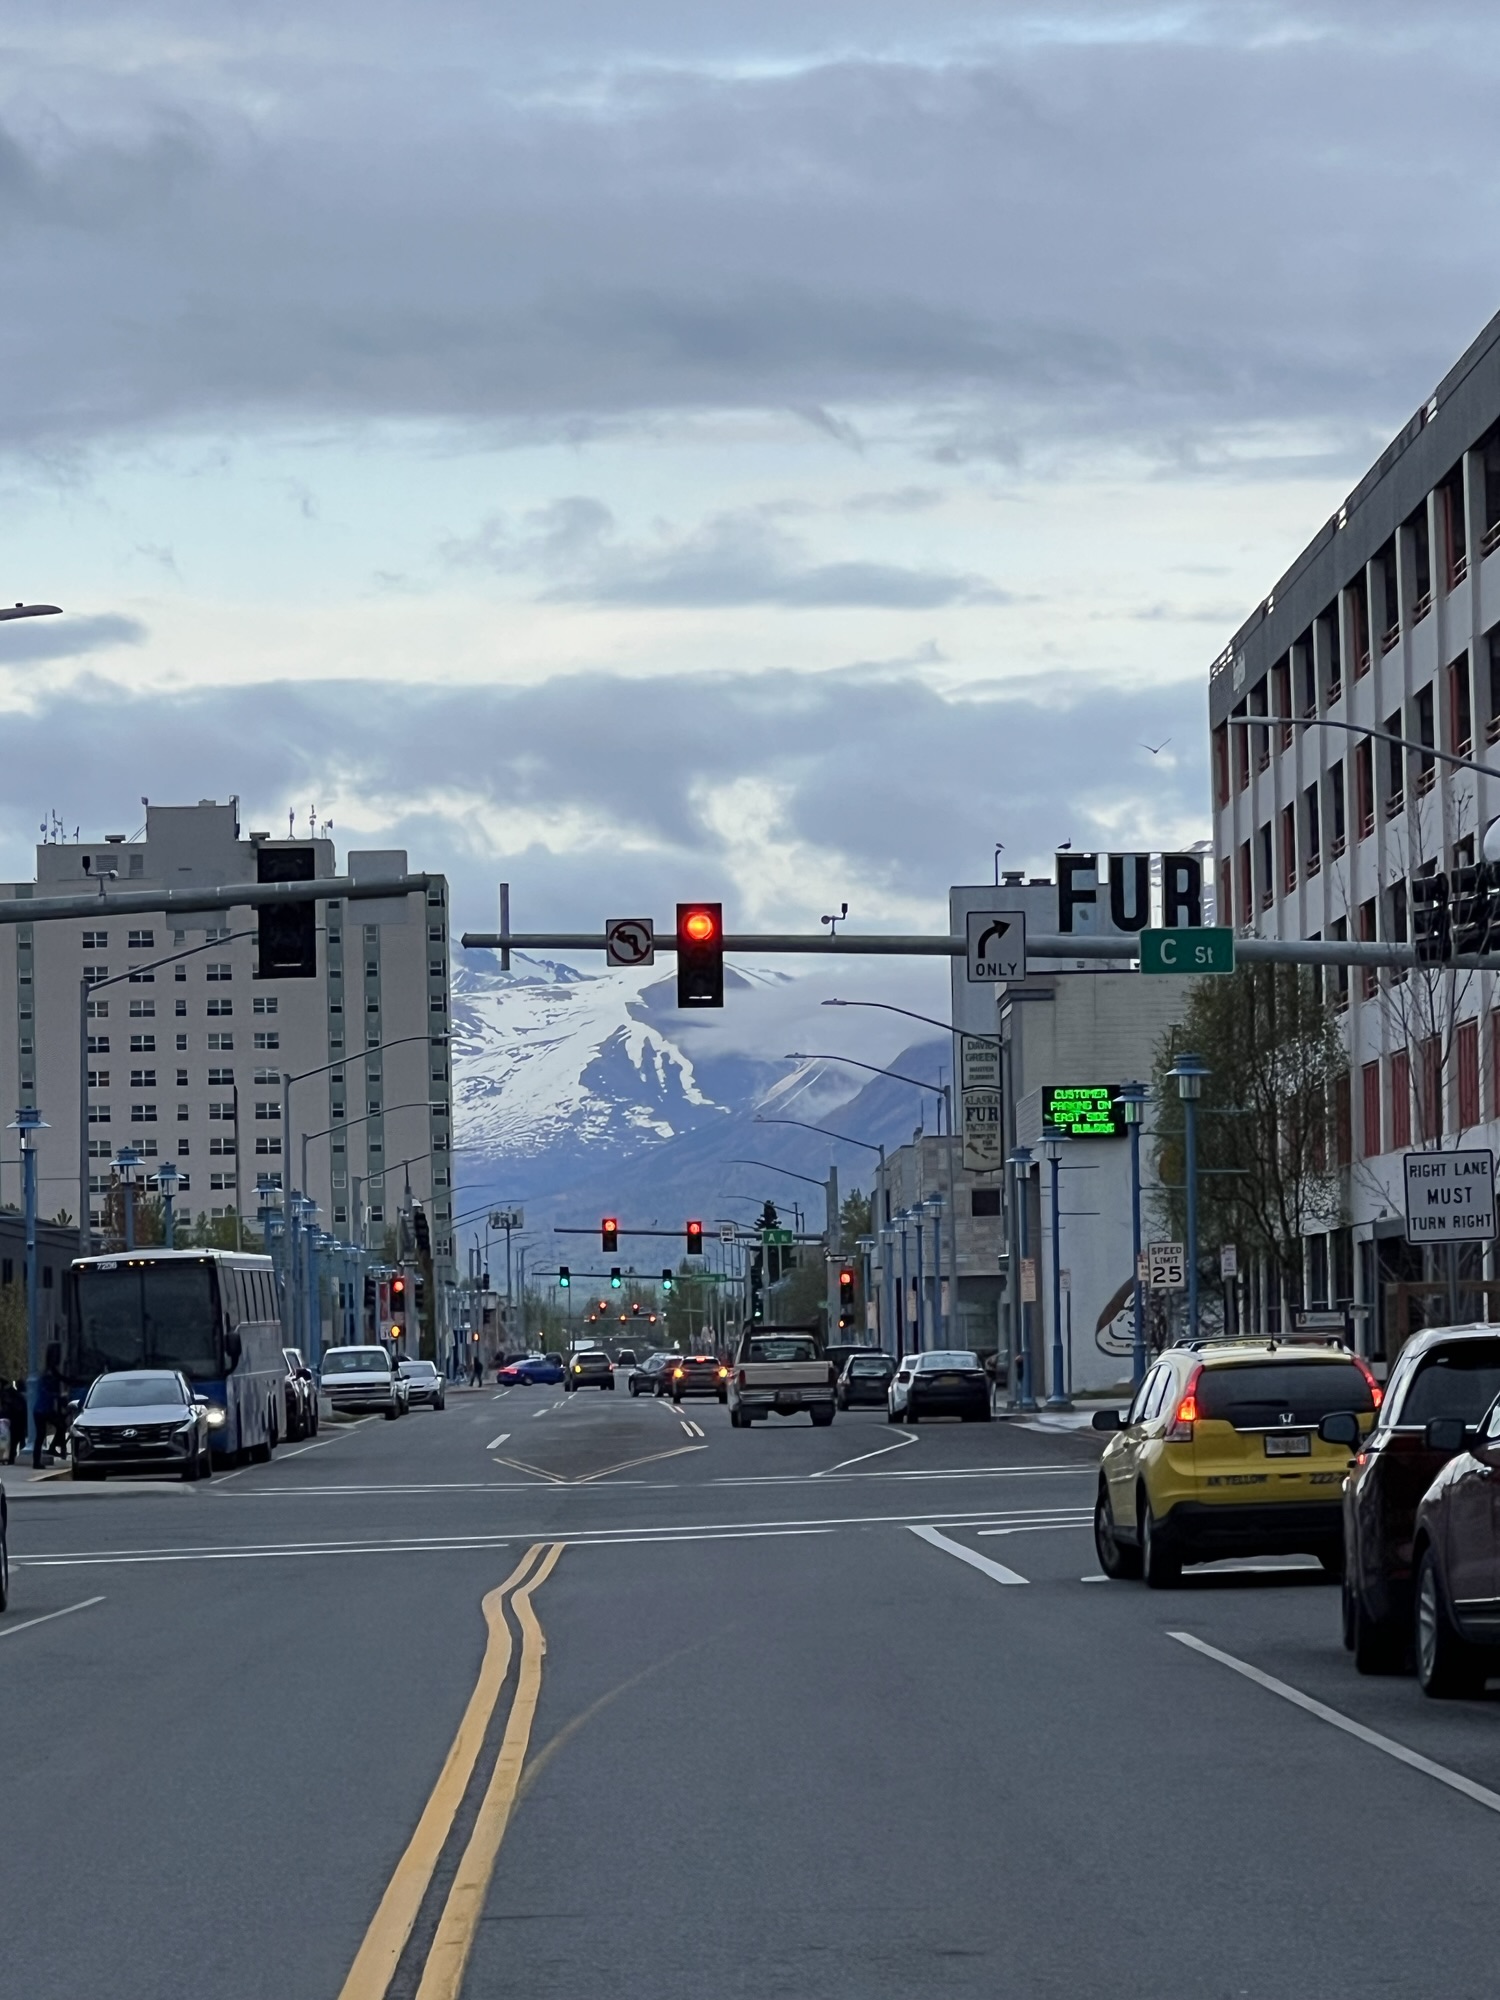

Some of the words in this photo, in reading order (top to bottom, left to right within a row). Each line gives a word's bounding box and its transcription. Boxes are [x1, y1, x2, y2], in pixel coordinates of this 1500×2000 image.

[1058, 856, 1202, 933] FUR
[1160, 938, 1177, 965] C
[1195, 946, 1214, 964] St
[975, 963, 1018, 977] ONLY
[965, 1053, 998, 1062] GREEN
[1054, 1088, 1108, 1099] CUSTOMER
[1050, 1101, 1093, 1111] PARKING
[1097, 1100, 1112, 1110] ON
[966, 1107, 998, 1122] FUR
[1054, 1112, 1080, 1122] EAST
[1086, 1111, 1109, 1122] SIDE
[1072, 1123, 1115, 1133] BUILDING
[1409, 1163, 1446, 1178] RIGHT
[1454, 1161, 1488, 1176] LANE
[1427, 1187, 1472, 1205] MUST
[1411, 1216, 1446, 1231] TURN
[1453, 1213, 1491, 1228] RIGHT
[1151, 1246, 1182, 1255] SPEED
[1154, 1256, 1178, 1264] LIMIT
[1152, 1266, 1182, 1283] 25
